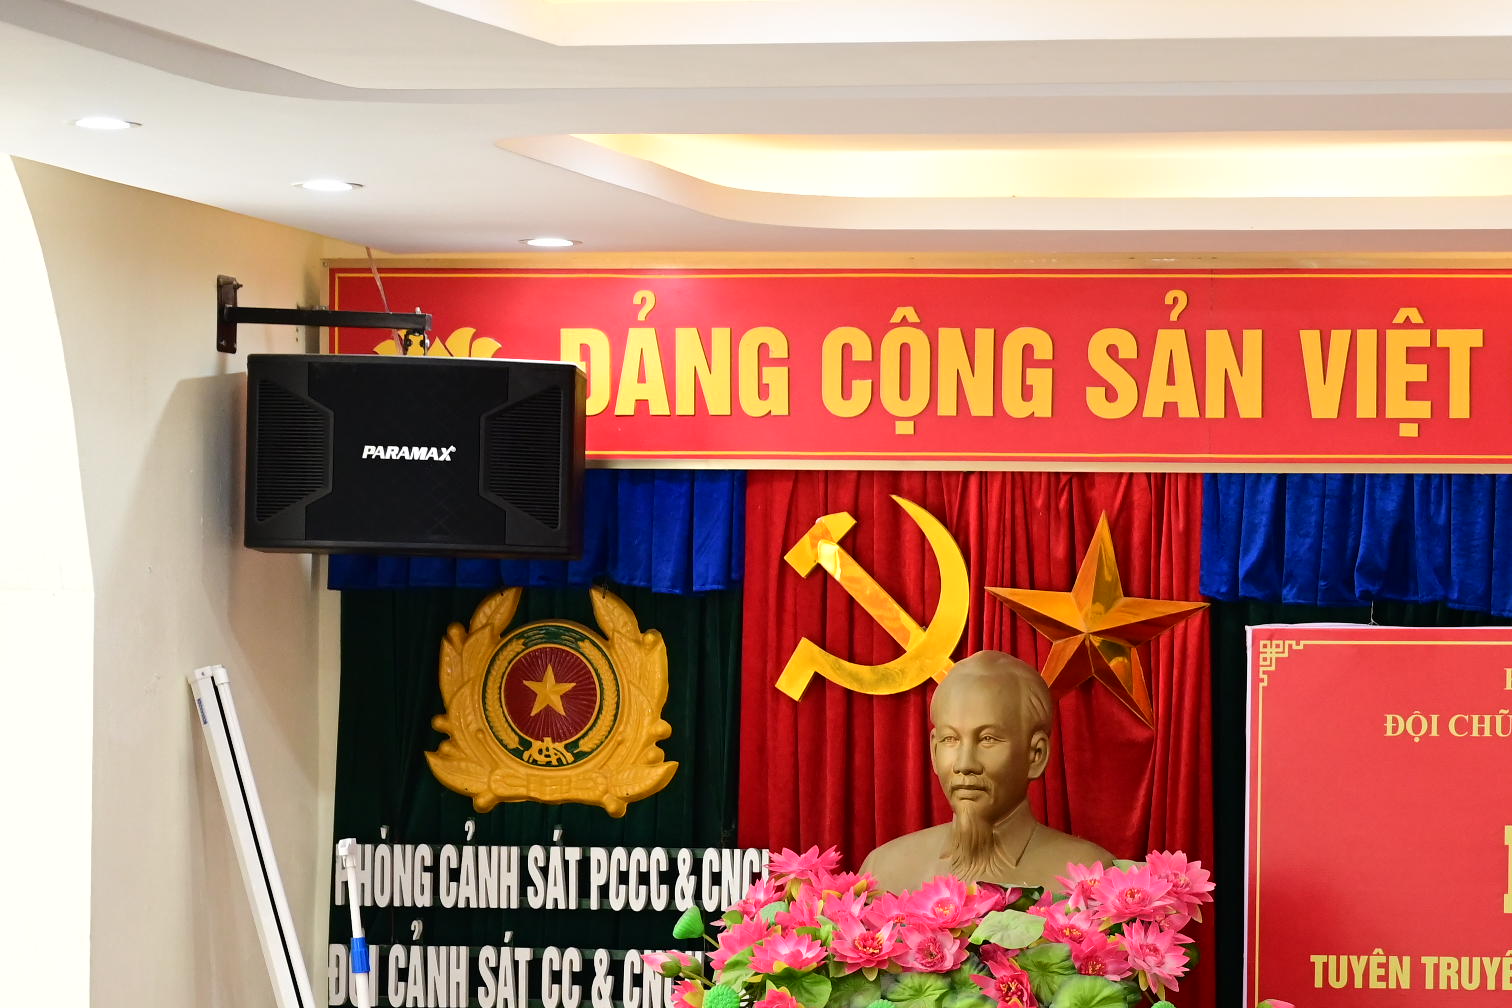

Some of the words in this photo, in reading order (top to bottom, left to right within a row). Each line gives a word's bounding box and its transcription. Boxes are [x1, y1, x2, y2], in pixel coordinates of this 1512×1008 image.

[560, 290, 789, 417] ĐẢNG
[821, 306, 1053, 435] CỘNG
[1085, 290, 1263, 419] SẢN
[1299, 307, 1484, 437] VIỆT
[362, 445, 456, 461] PARAMAX
[1383, 711, 1440, 743] ĐỘI
[439, 820, 520, 909] CẢNH
[527, 825, 582, 910] SÁT
[590, 846, 668, 912] PCCC
[675, 849, 697, 911] &
[388, 919, 469, 1008] CẢNH
[1310, 948, 1411, 990] TUYÊN
